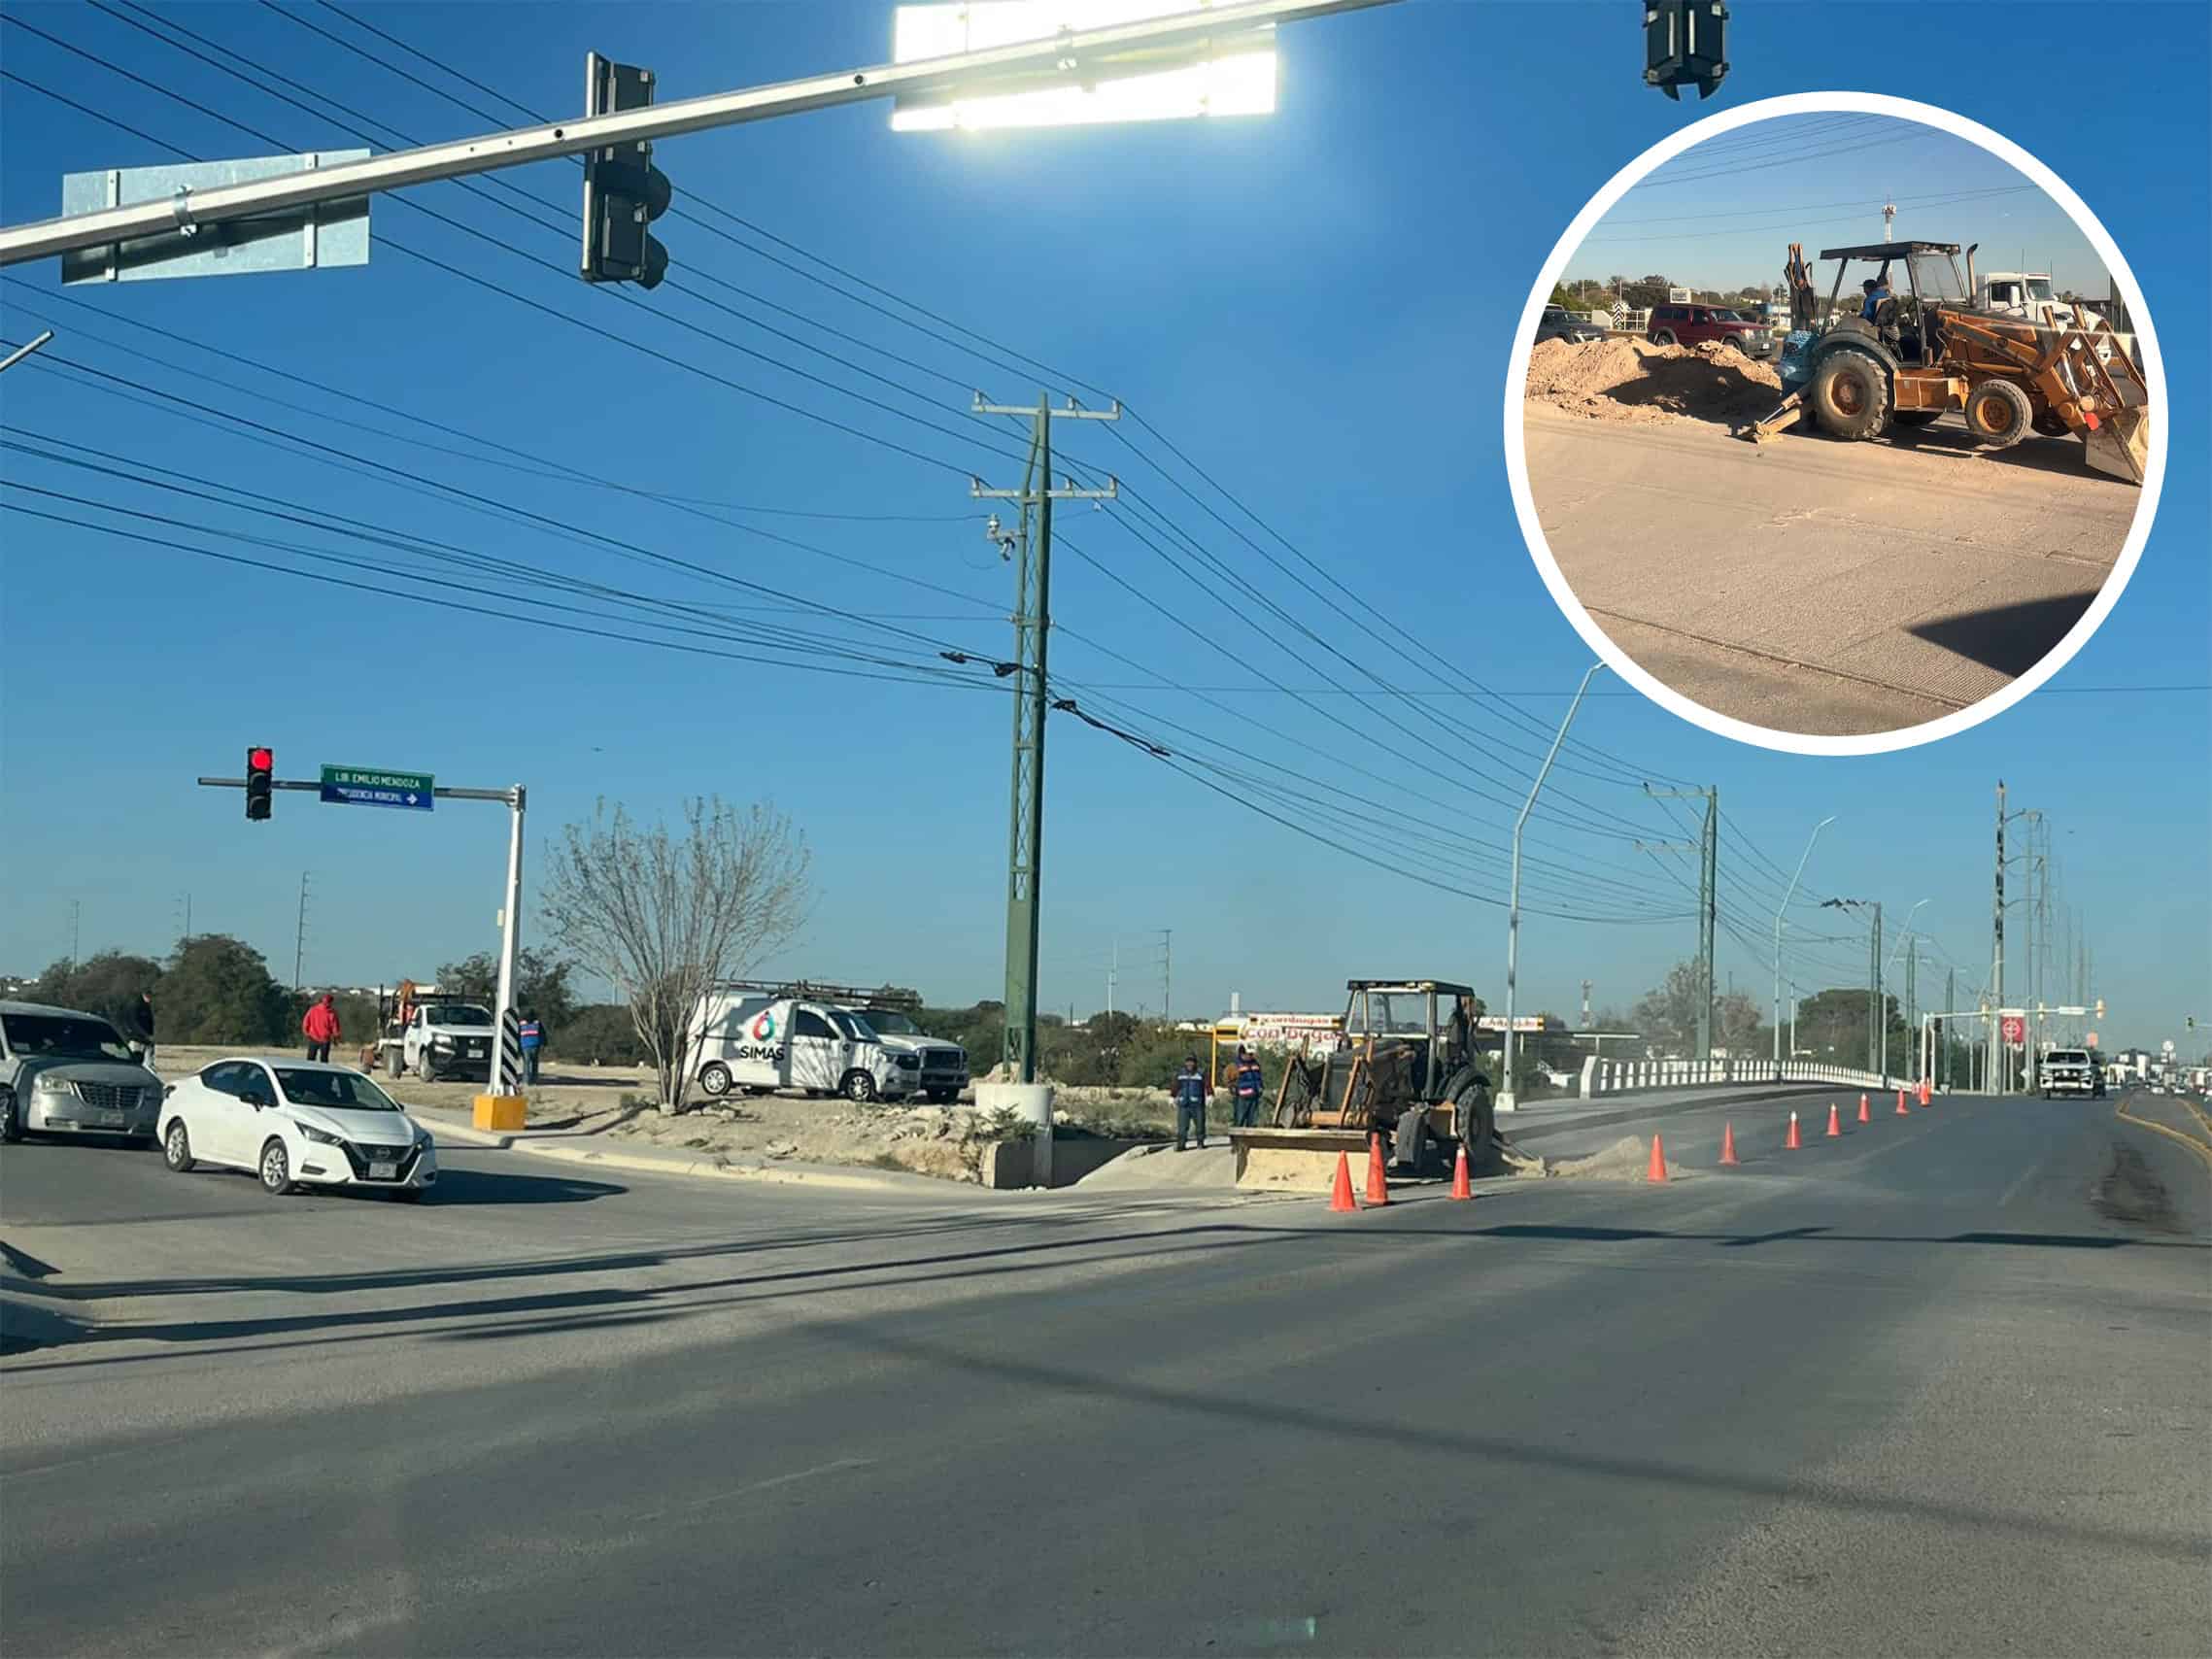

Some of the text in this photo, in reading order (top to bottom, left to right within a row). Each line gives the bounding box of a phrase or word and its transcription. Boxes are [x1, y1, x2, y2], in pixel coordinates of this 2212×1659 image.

[353, 773, 380, 785] EMILIO
[381, 776, 420, 788] MENDOZA
[740, 1045, 784, 1062] SIMAS
